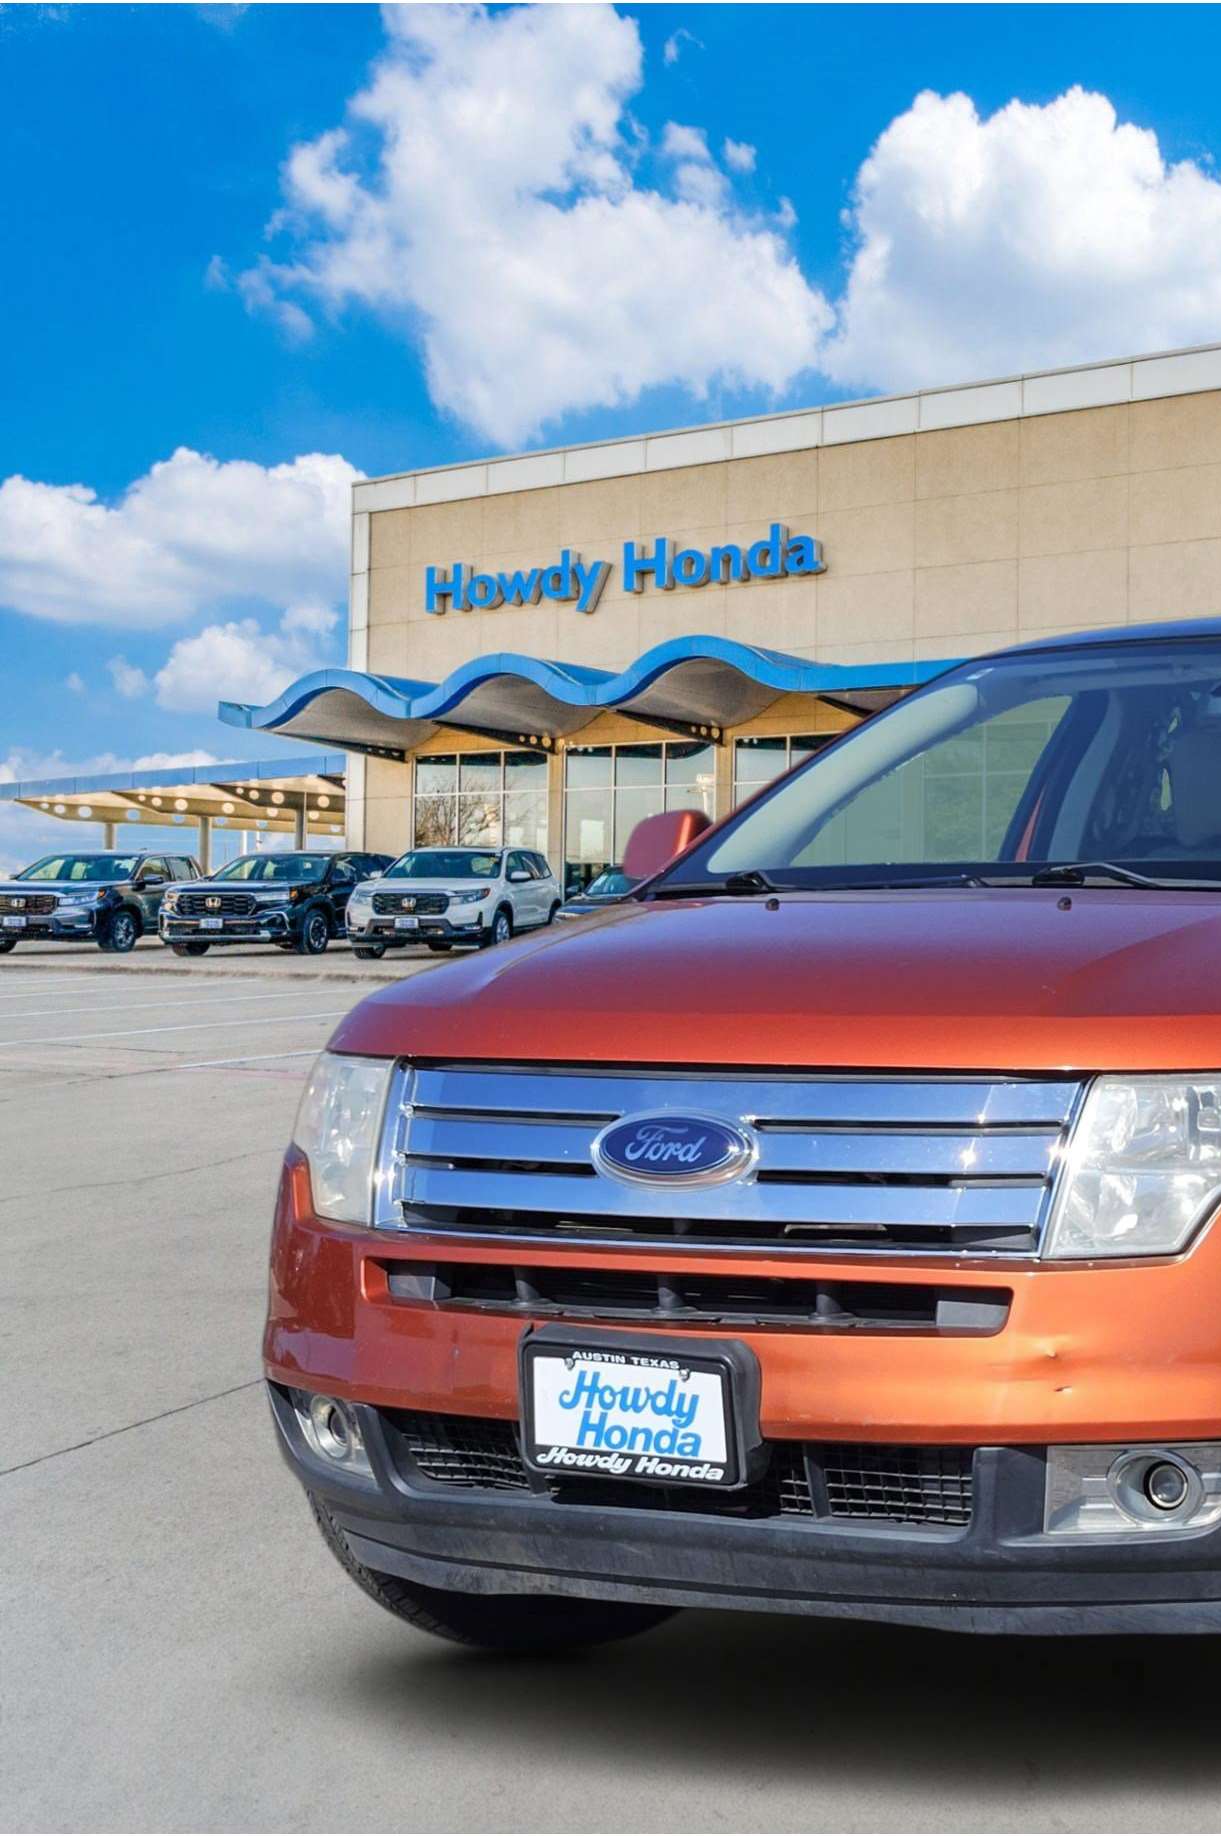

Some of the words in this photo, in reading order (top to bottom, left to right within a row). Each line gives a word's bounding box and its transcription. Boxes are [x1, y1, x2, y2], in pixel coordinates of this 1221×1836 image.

[425, 548, 609, 613] Howdy
[623, 522, 823, 593] Honda
[624, 1124, 707, 1163] Ford
[572, 1350, 627, 1364] AUSTIN
[631, 1356, 680, 1370] TEXAS
[558, 1370, 700, 1429] Howdy
[576, 1410, 702, 1457] Honda
[536, 1446, 634, 1474] Howdy
[634, 1457, 725, 1481] Honda
